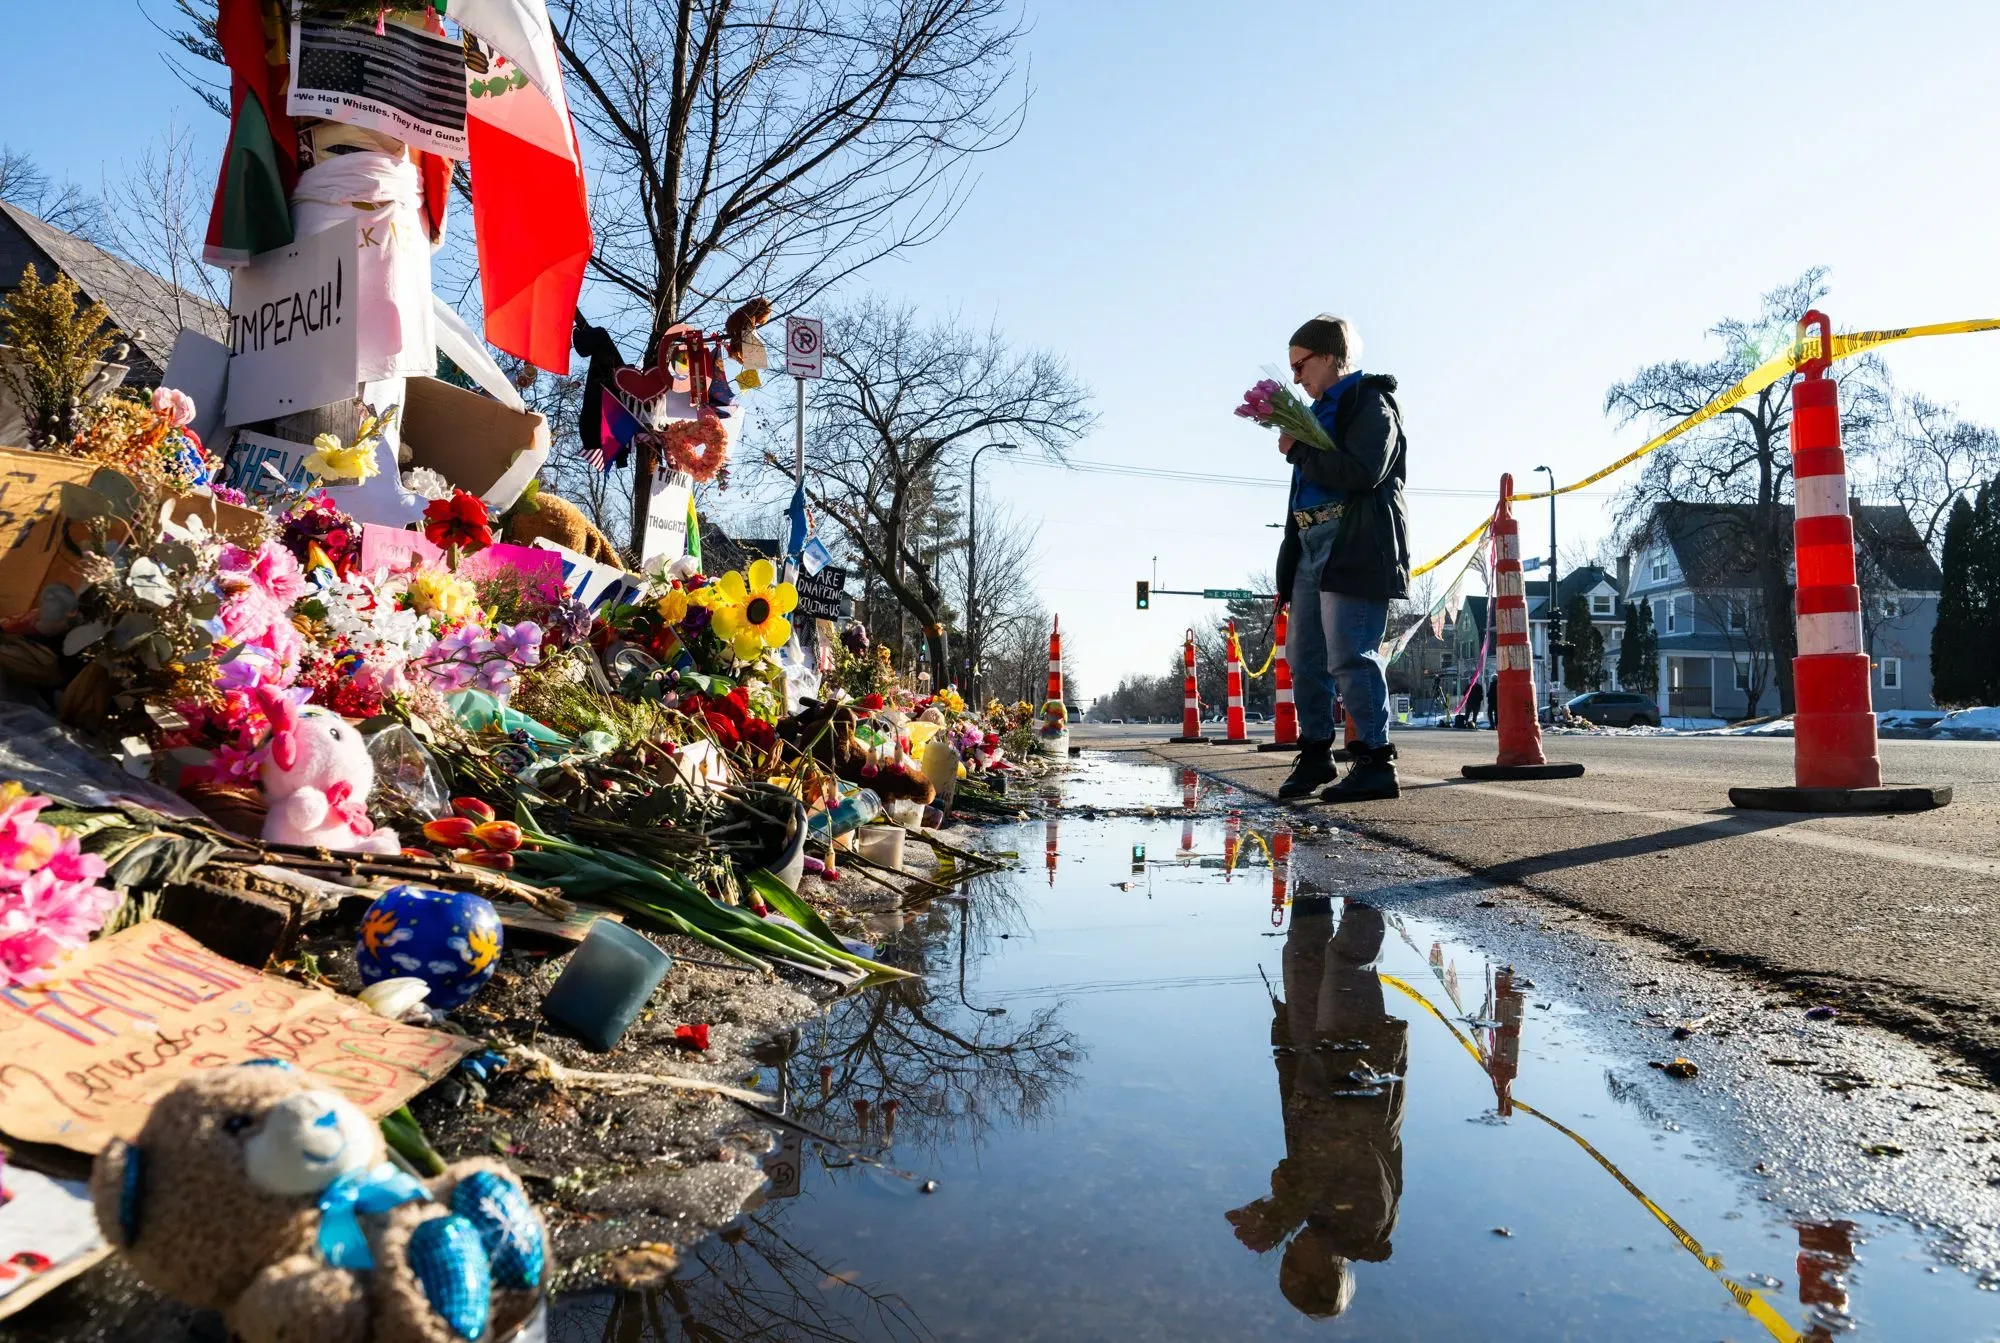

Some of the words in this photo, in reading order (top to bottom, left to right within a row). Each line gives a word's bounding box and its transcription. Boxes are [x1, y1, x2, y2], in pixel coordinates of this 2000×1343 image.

[318, 94, 339, 104] Had
[343, 97, 390, 118] Whistles.
[392, 112, 412, 129] They
[413, 122, 433, 136] Had
[435, 130, 466, 143] Guns”
[230, 256, 342, 358] IMPEACH!
[226, 443, 281, 491] SHE
[657, 465, 688, 489] THINK
[649, 515, 686, 534] THOUGHTS
[815, 568, 840, 587] ARE
[797, 579, 844, 601] DNAPPING
[1223, 591, 1241, 599] 34th
[829, 603, 840, 617] US
